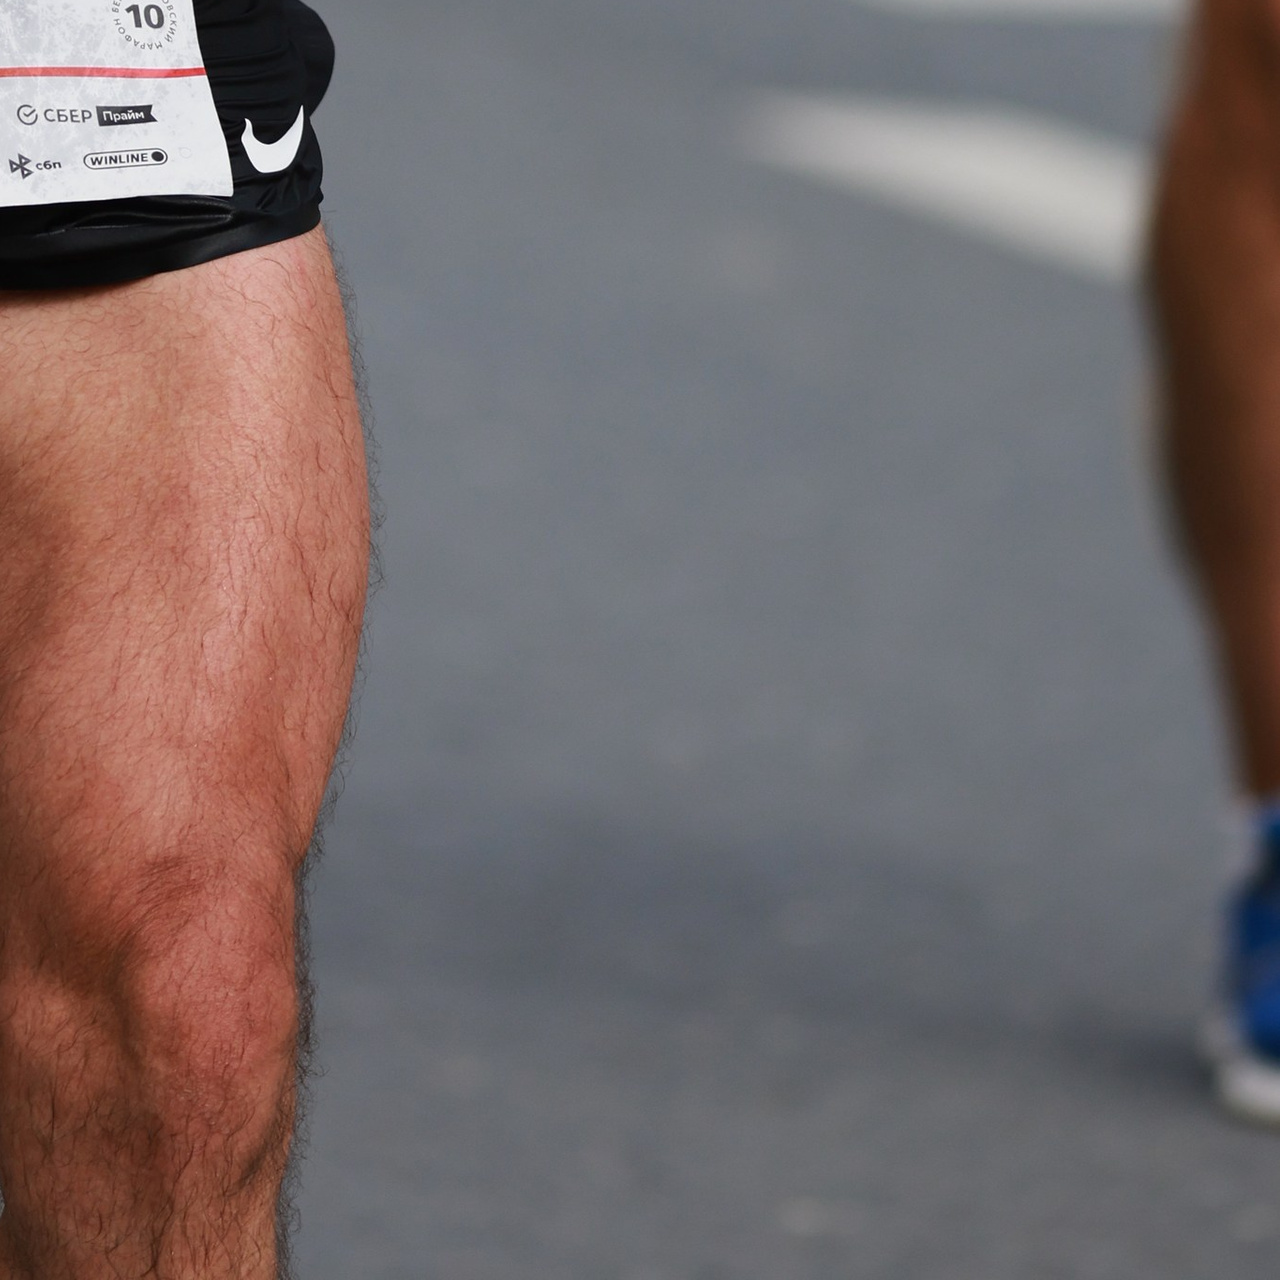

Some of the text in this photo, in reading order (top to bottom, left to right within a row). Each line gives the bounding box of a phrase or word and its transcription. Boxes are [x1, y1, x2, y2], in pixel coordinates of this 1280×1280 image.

[125, 4, 165, 30] 10
[113, 18, 163, 50] МАРАФОН
[43, 108, 145, 123] СБЕР Прайм
[35, 160, 62, 171] сбп
[90, 152, 149, 166] WINLINE
